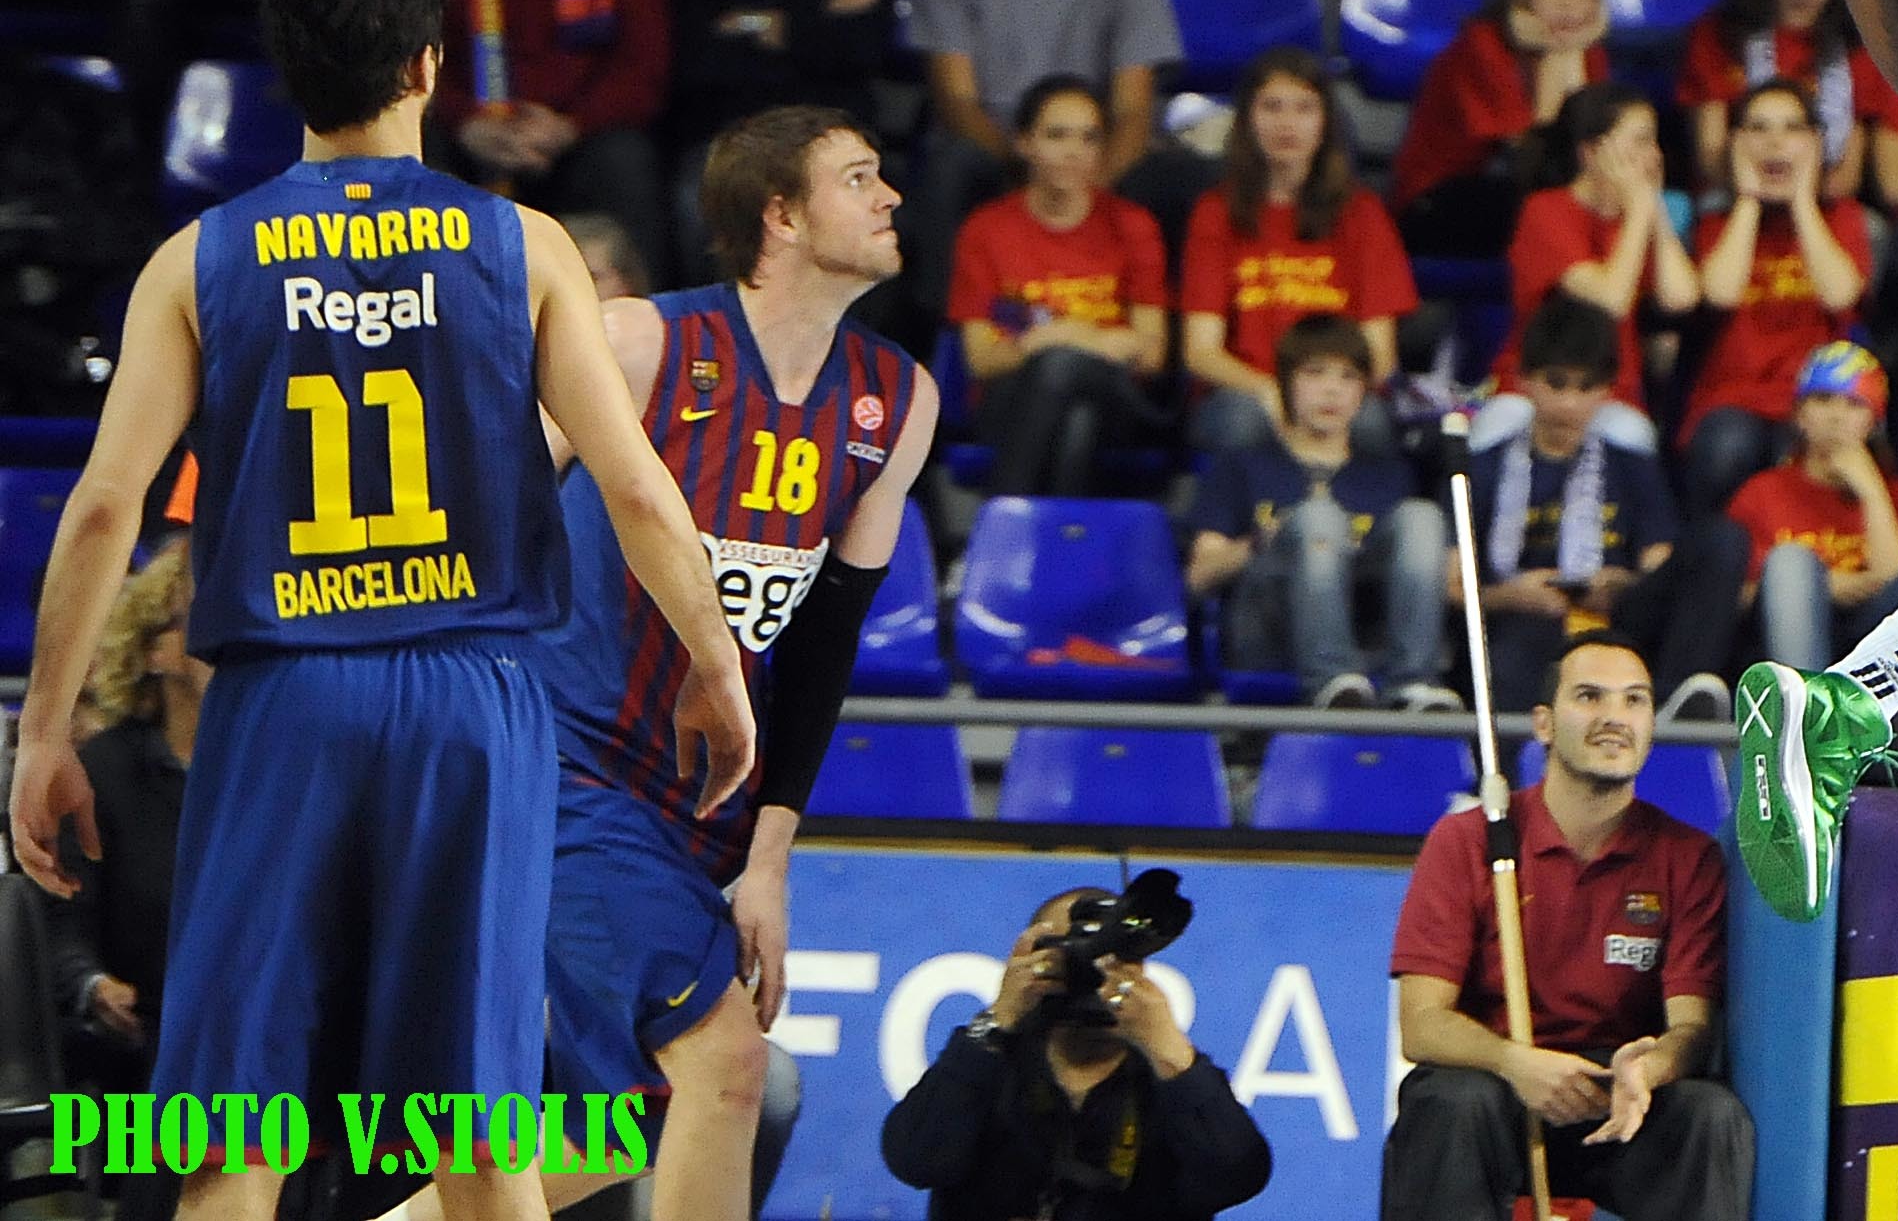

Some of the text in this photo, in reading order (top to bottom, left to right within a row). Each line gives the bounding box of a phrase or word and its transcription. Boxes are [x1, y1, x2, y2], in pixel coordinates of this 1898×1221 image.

[255, 207, 471, 265] NAVARRO
[284, 272, 438, 347] Regal
[286, 369, 449, 556] 11
[739, 430, 821, 516] 18
[273, 551, 477, 620] BARCELONA
